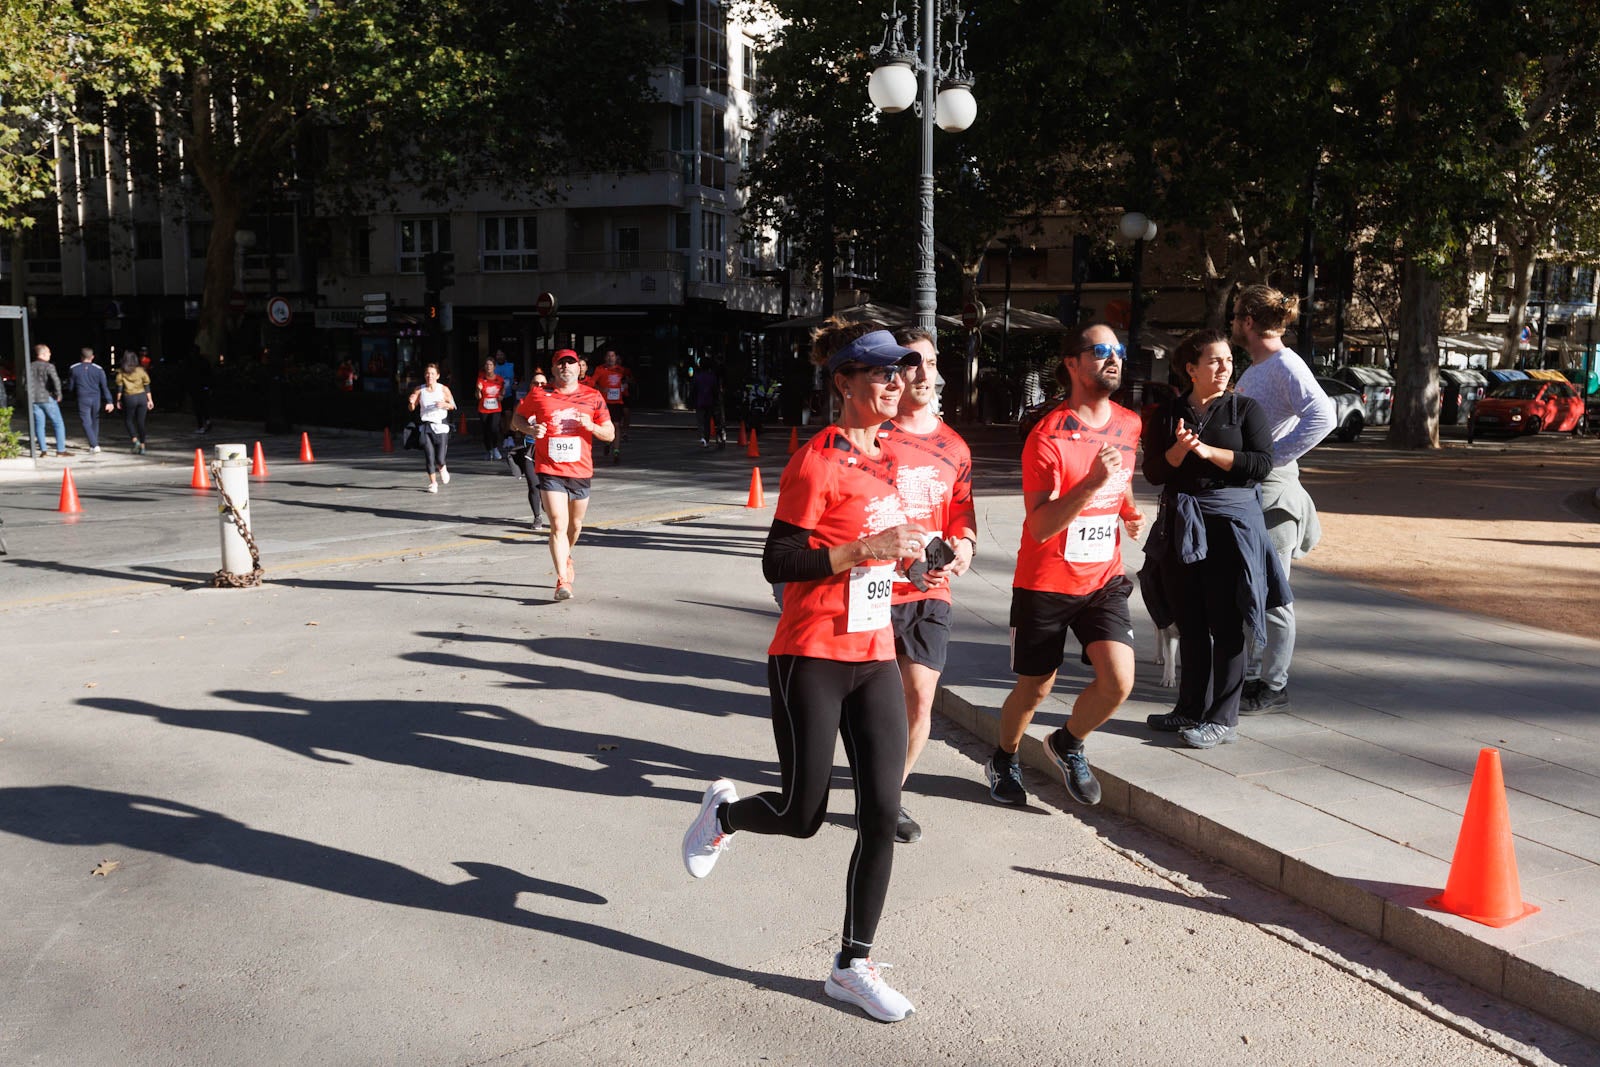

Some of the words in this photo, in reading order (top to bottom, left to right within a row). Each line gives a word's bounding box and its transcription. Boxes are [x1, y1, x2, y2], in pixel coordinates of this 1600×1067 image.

[556, 443, 574, 451] 994
[1078, 525, 1111, 541] 1254
[867, 579, 891, 600] 998
